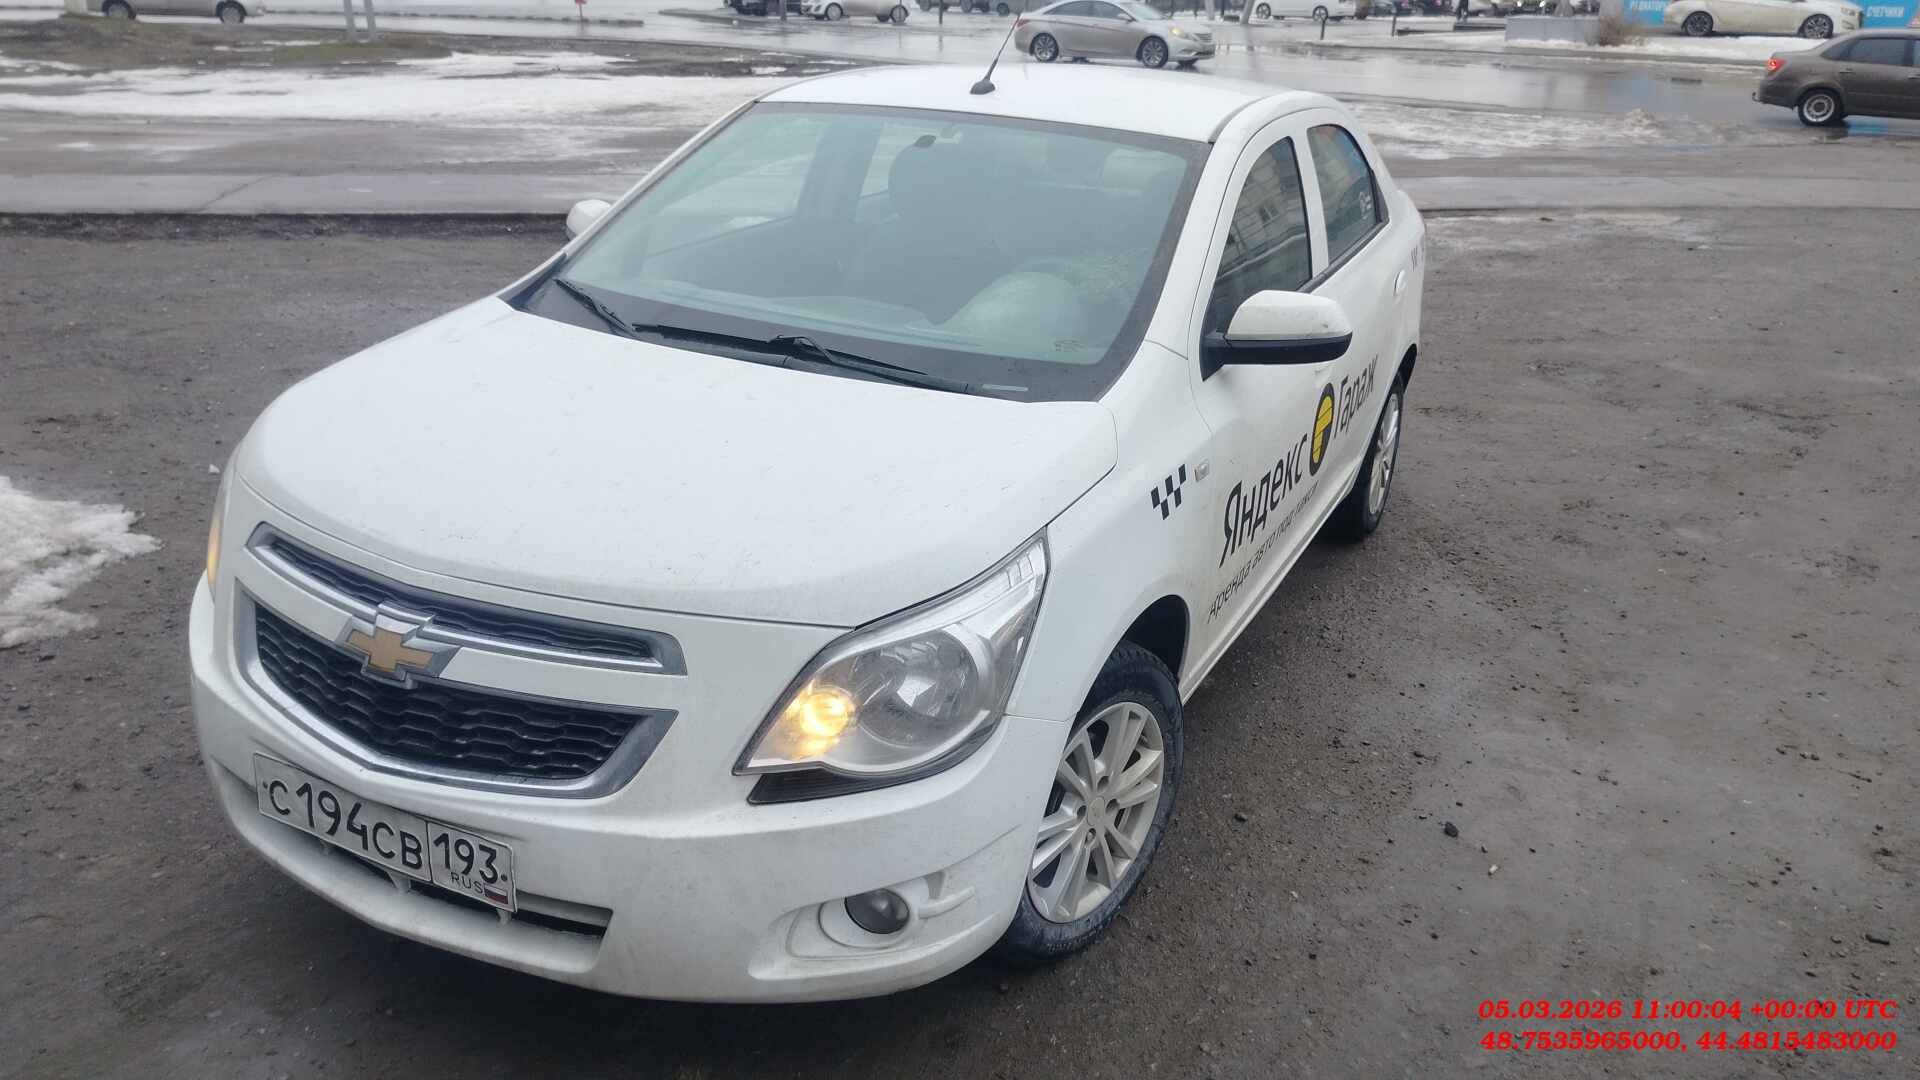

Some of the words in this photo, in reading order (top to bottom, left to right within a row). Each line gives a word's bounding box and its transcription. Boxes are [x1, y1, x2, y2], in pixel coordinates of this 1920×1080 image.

[1219, 433, 1307, 569] Яндекс
[1334, 354, 1378, 438] Гараж
[434, 832, 499, 884] 193
[451, 871, 483, 895] RUS
